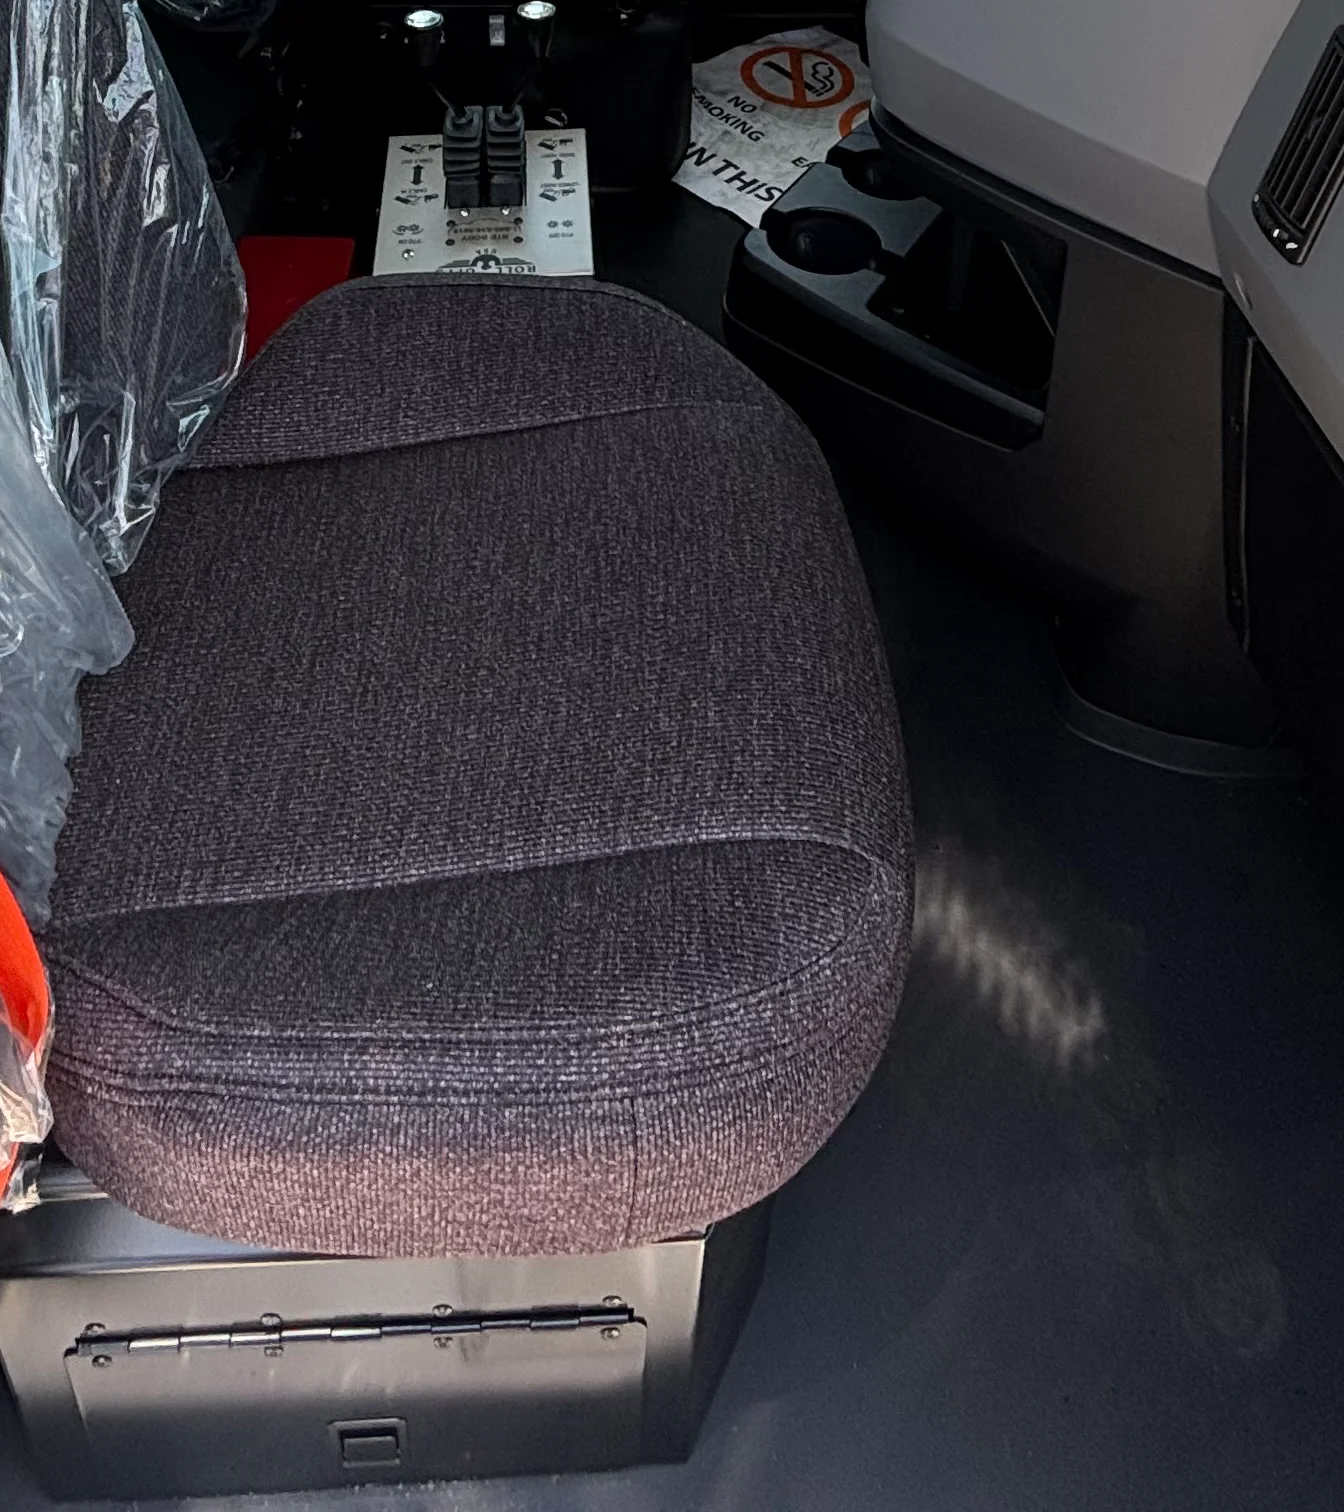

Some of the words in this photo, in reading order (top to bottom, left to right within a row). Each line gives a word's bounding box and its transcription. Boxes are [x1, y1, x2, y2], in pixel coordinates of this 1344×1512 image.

[727, 95, 758, 113] NO
[712, 158, 784, 202] THIS
[494, 265, 536, 274] ROLL
